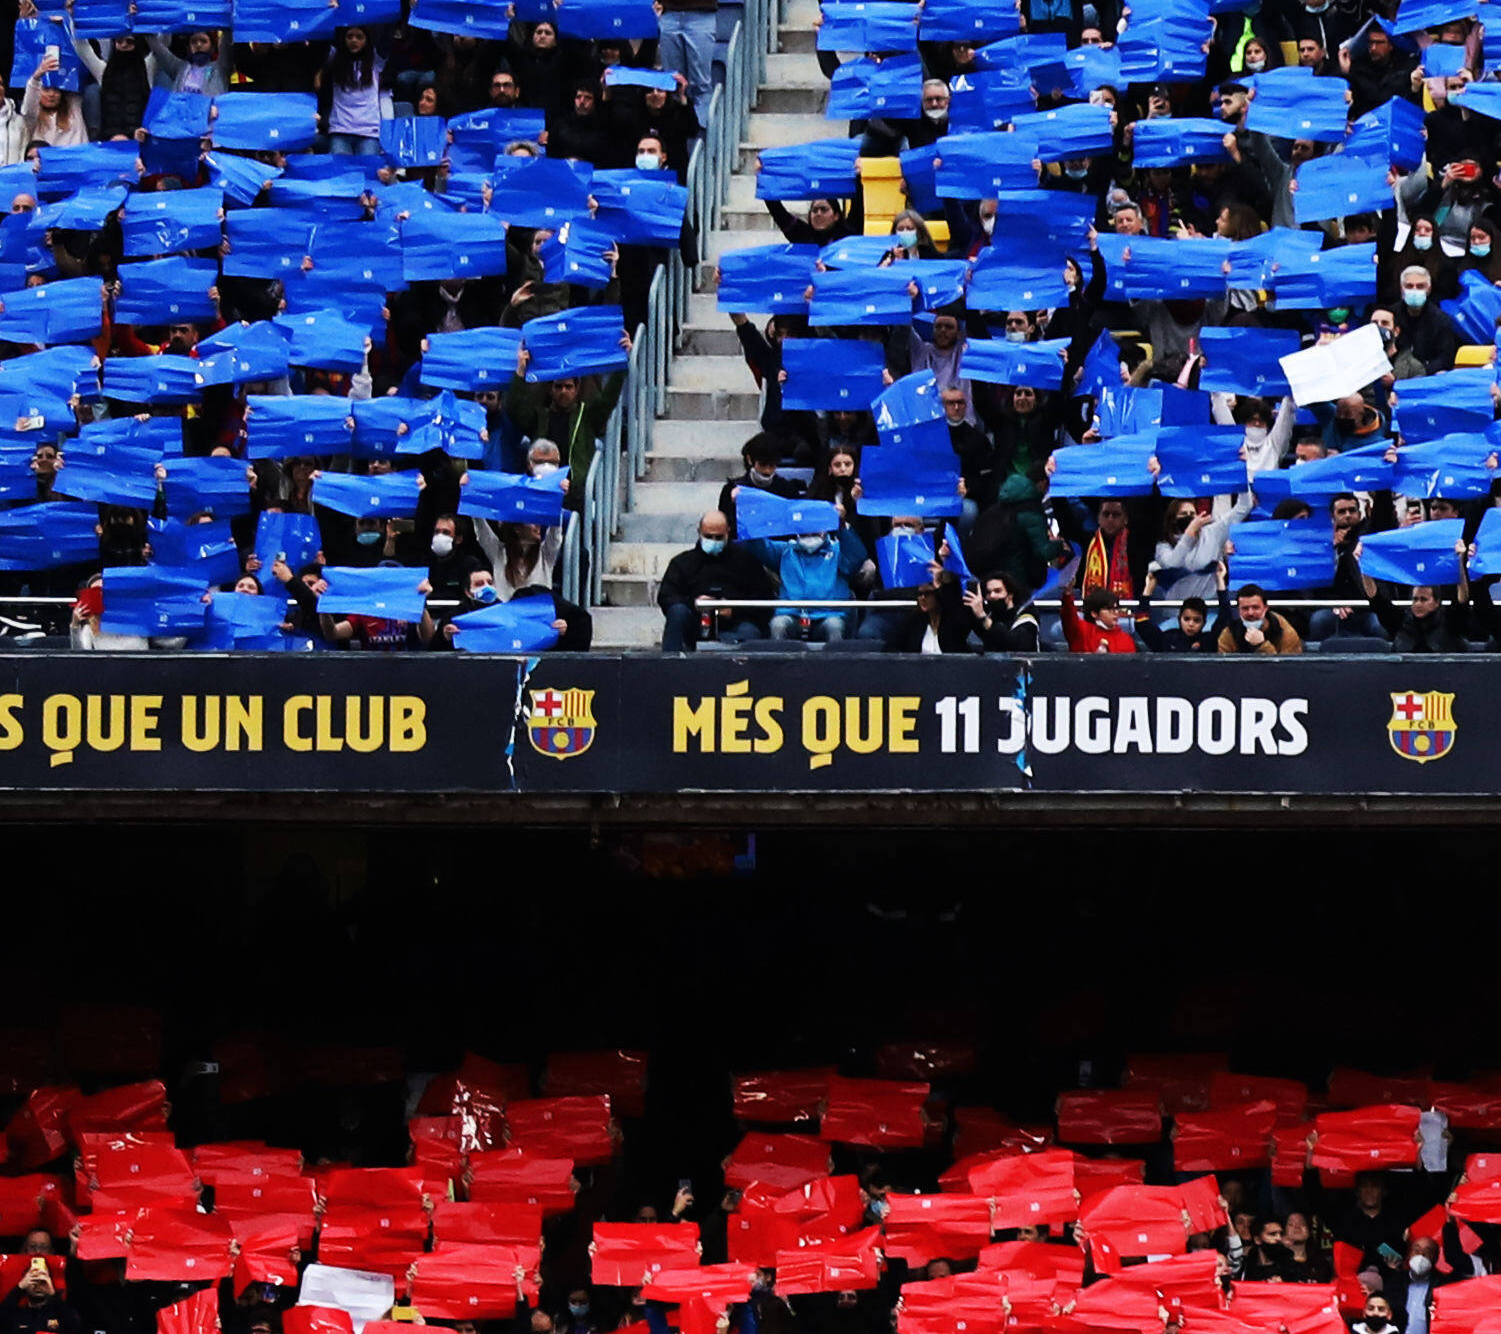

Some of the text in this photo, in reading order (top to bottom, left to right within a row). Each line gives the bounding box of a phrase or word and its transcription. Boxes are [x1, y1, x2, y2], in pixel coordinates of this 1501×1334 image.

[43, 694, 163, 768] QUE
[182, 695, 263, 752] UN
[284, 695, 427, 753] CLUB
[674, 680, 1309, 769] MÉS QUE 11 JUGADORS
